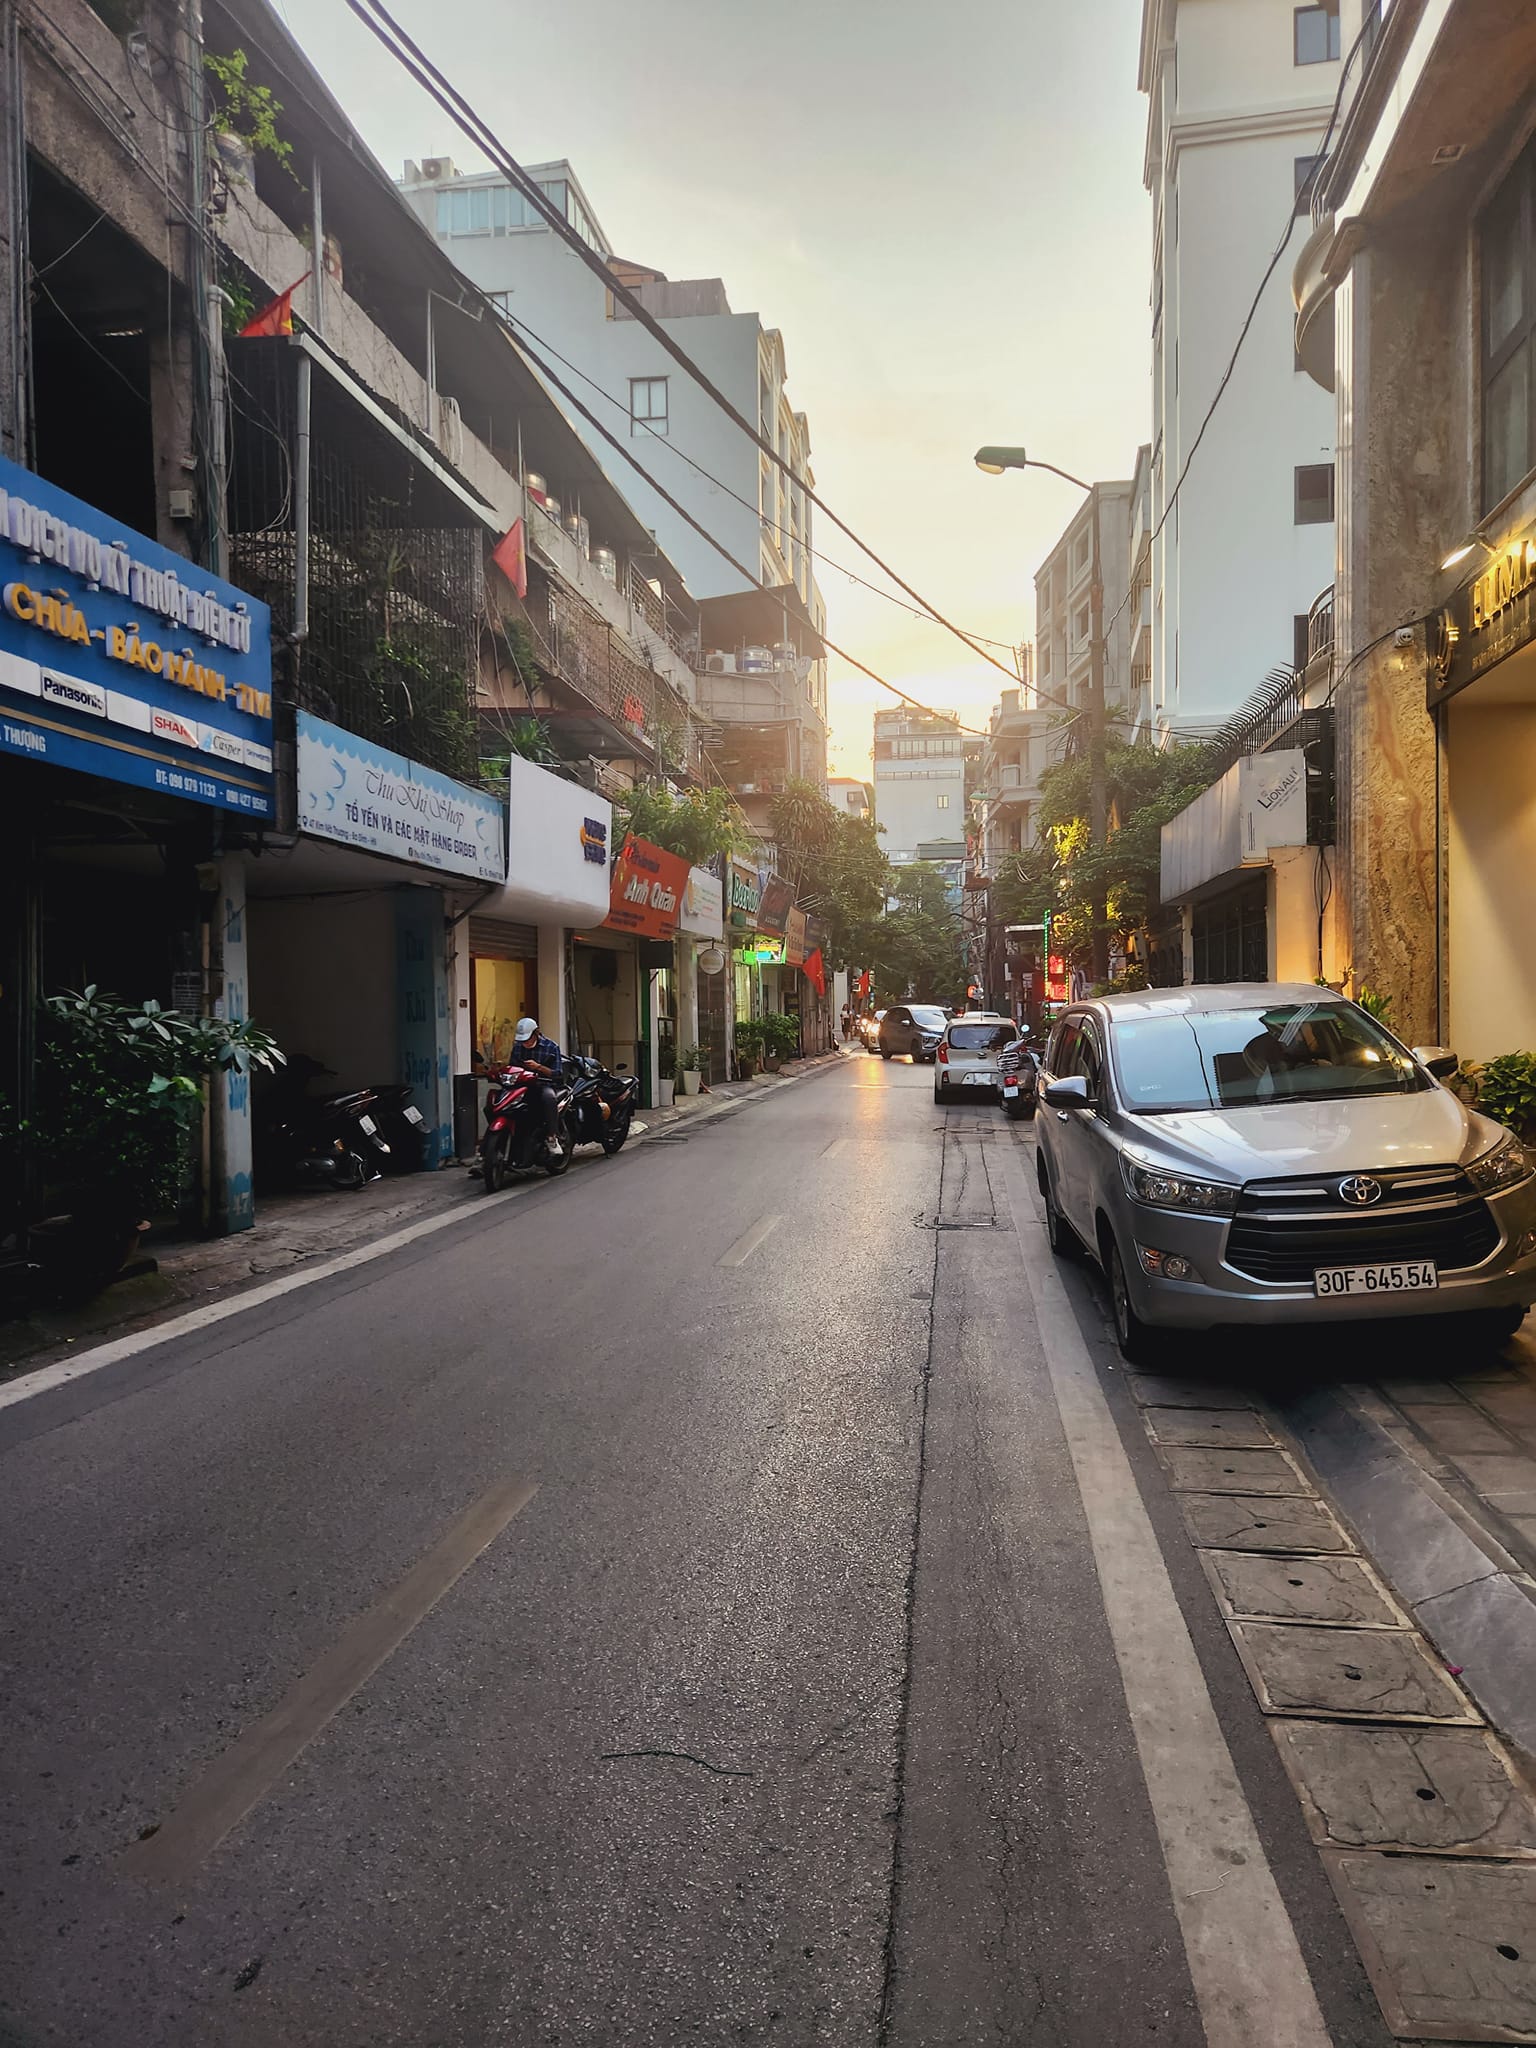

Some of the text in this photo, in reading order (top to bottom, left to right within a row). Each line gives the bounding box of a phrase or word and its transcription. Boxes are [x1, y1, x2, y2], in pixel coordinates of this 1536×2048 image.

[106, 621, 164, 674] BẢO
[624, 874, 650, 905] Anh
[1318, 1264, 1434, 1294] 30F-645.54
